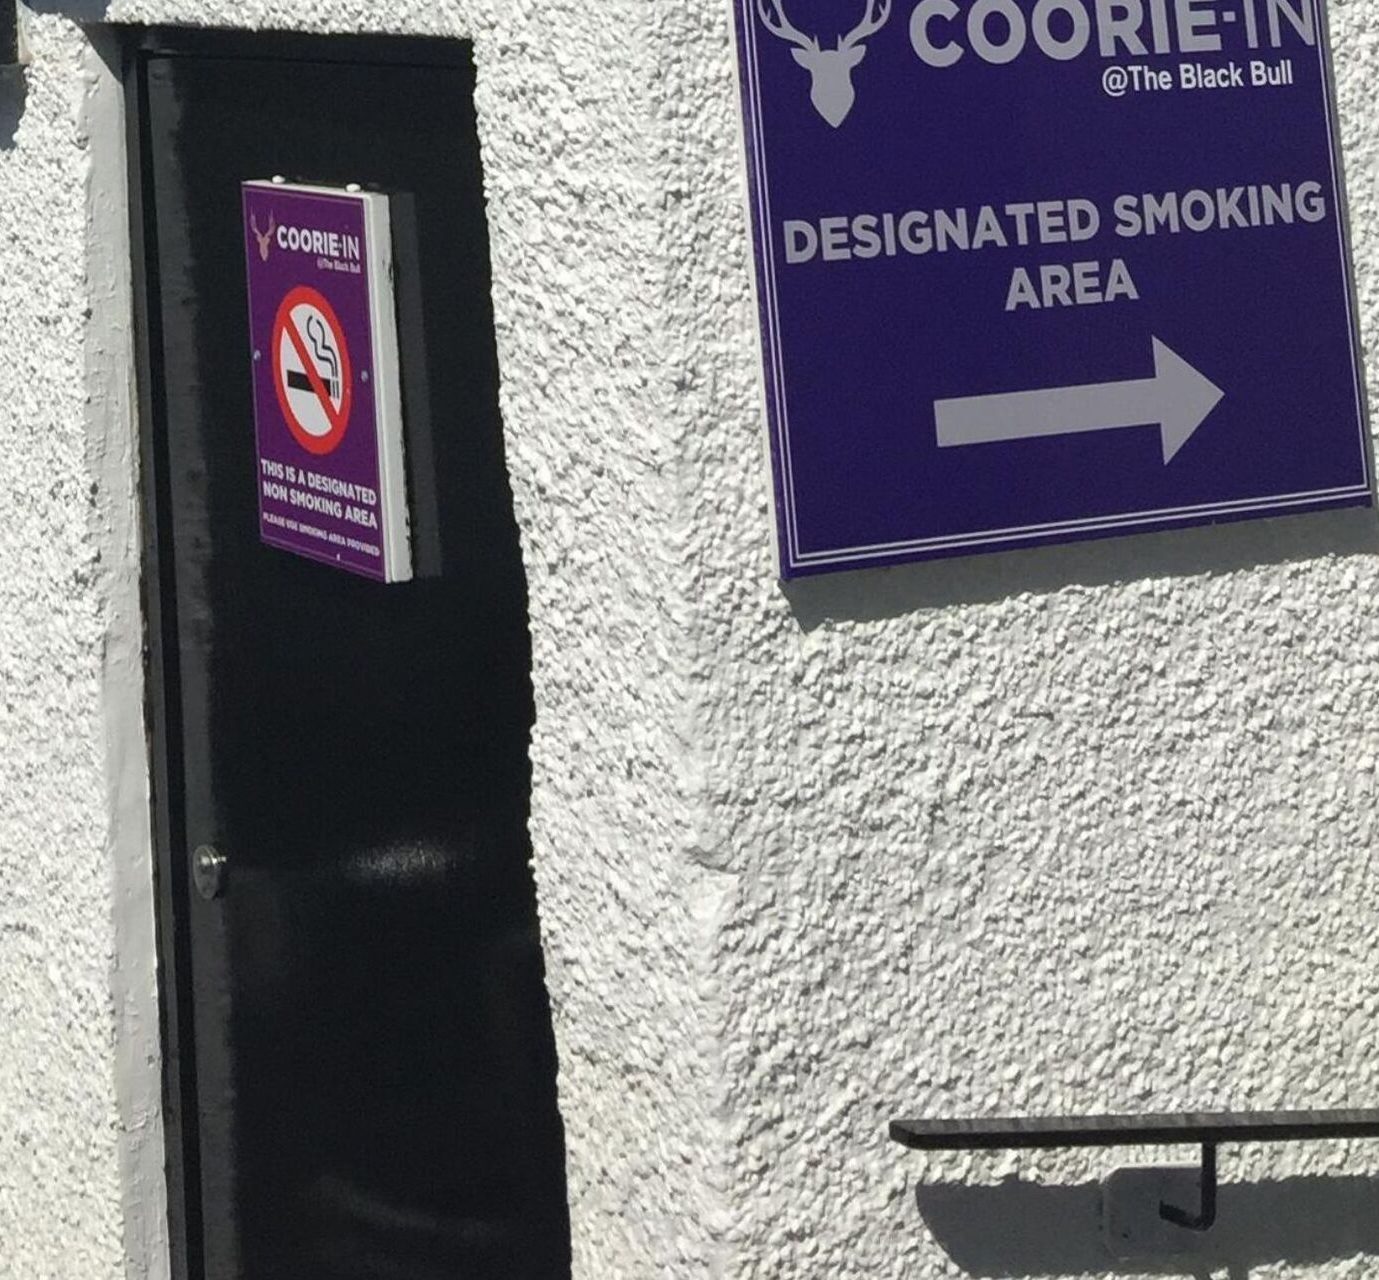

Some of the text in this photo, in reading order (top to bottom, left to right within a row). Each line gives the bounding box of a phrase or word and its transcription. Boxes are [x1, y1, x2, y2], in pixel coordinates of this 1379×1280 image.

[1102, 60, 1293, 97] @The Black Bull
[277, 225, 360, 260] COORIE-IN
[783, 181, 1326, 264] DESIGNATED SMOKING
[1005, 259, 1139, 311] AREA
[261, 458, 377, 506] THIS IS A DESIGNATED
[263, 481, 378, 530] NON SMOKING AREA
[329, 532, 346, 546] AREA
[346, 538, 380, 557] PROVIDED
